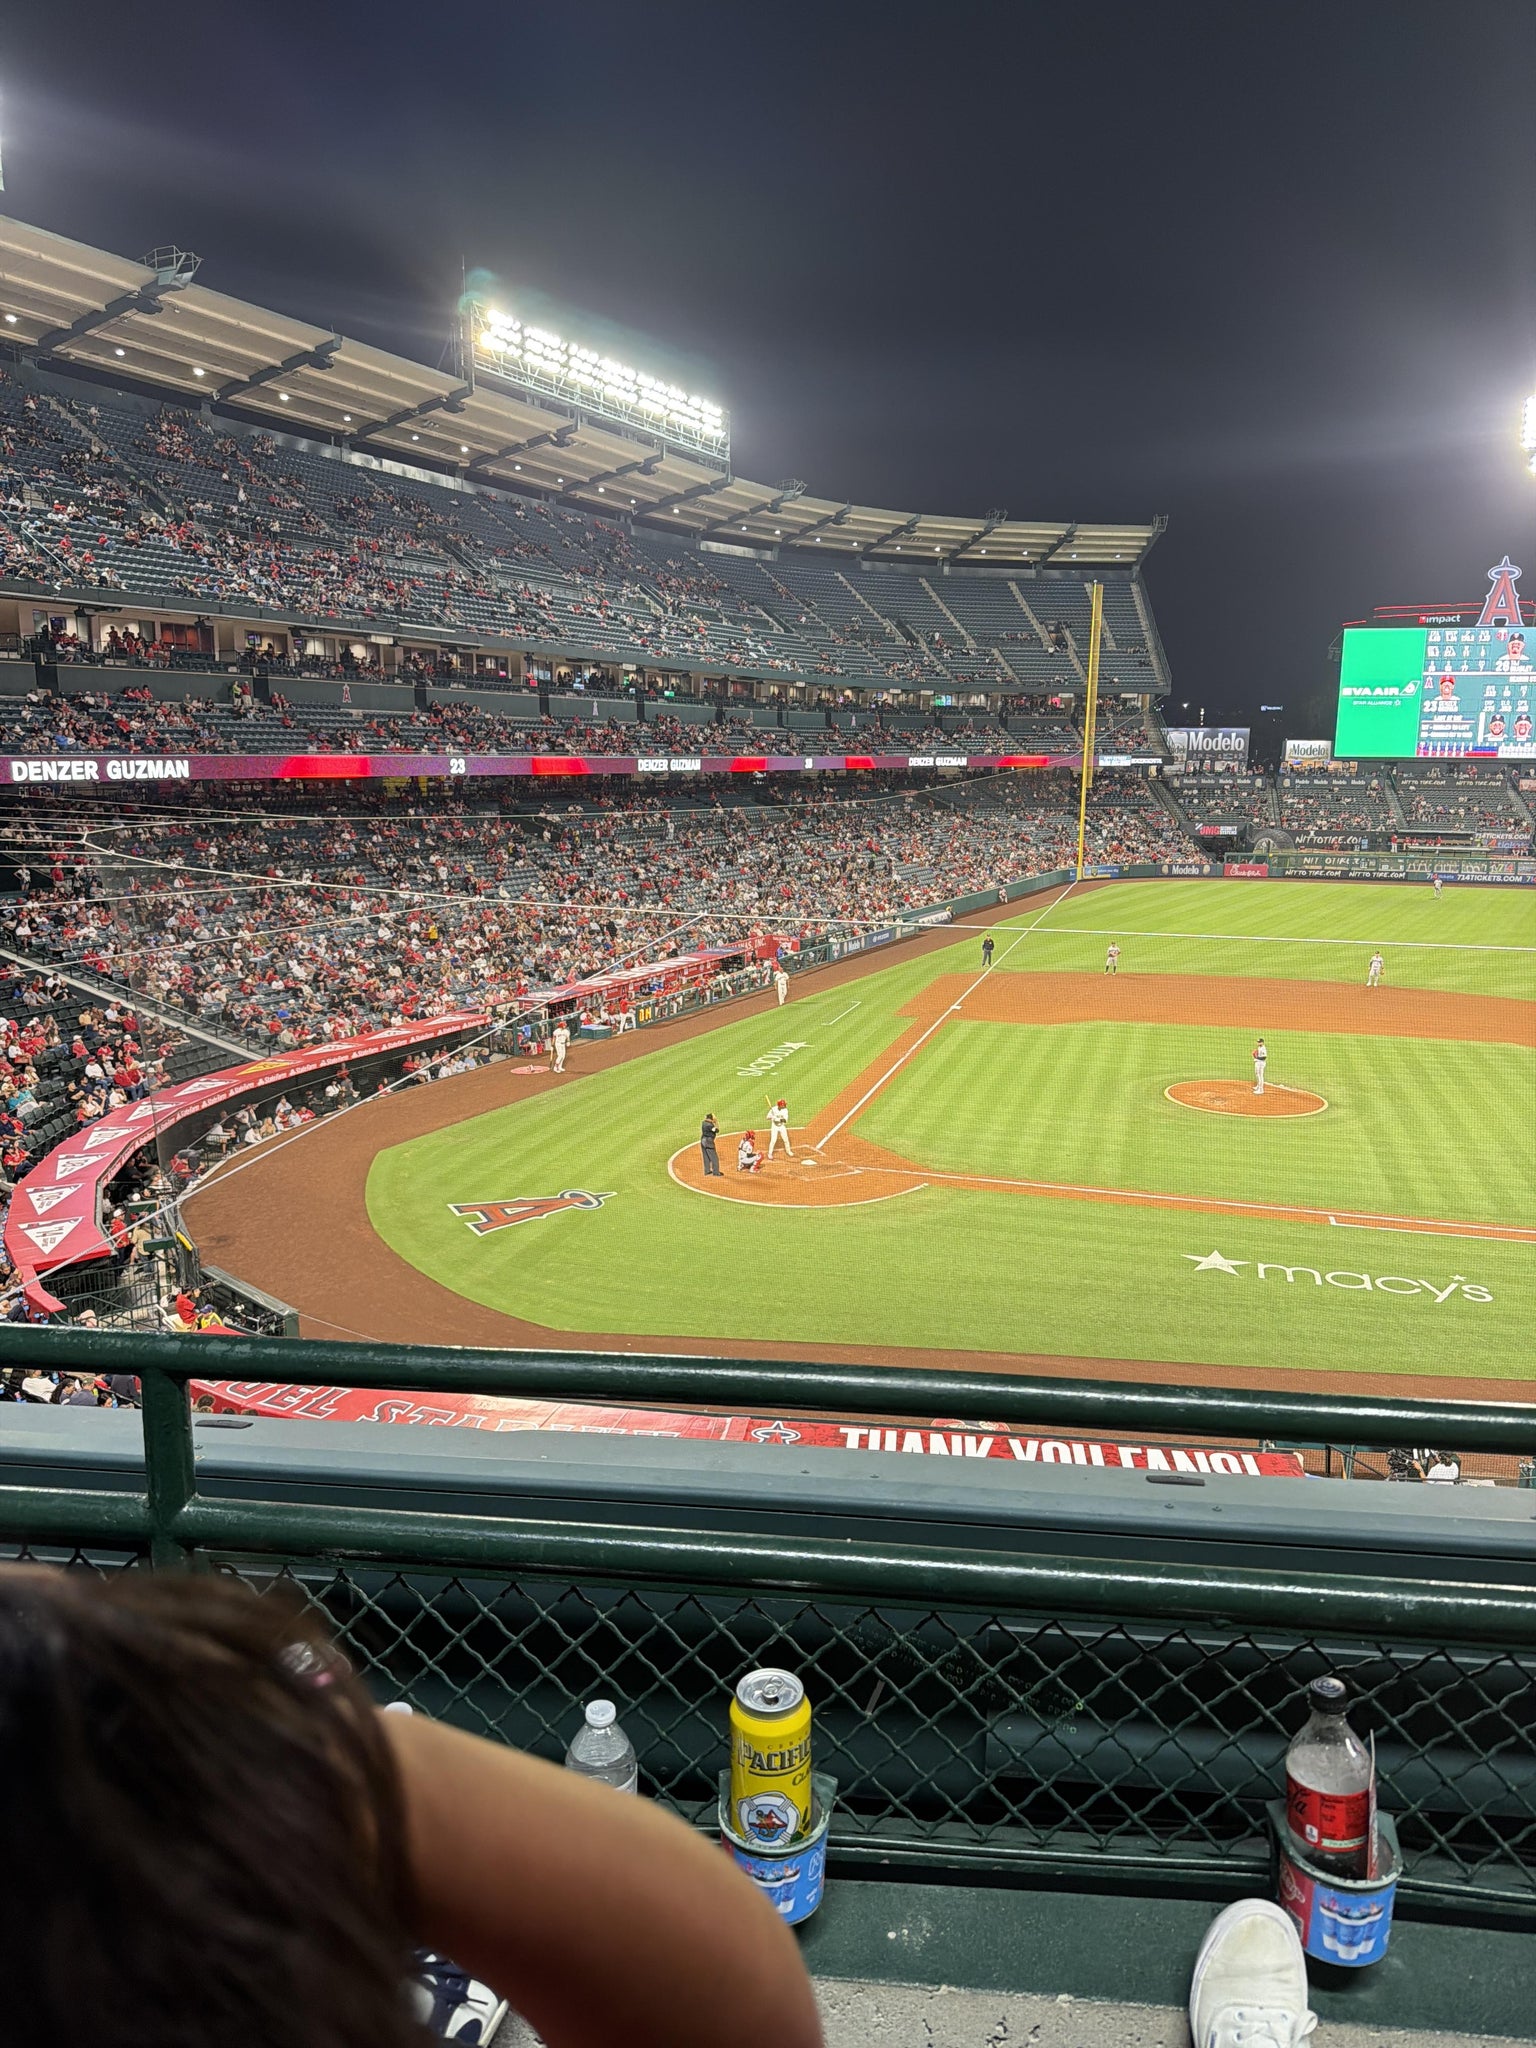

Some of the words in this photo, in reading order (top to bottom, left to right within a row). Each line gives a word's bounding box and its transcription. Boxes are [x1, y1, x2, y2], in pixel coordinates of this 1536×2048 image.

[1188, 731, 1245, 751] Modelo
[1292, 743, 1326, 756] Modelo
[11, 760, 100, 782] DENZER
[105, 759, 190, 780] GUZMAN
[449, 758, 467, 774] 23
[637, 758, 669, 772] DENZER
[669, 758, 701, 771] GUZMAN
[1171, 865, 1199, 875] Modelo
[1285, 869, 1306, 877] NITTO
[1457, 875, 1523, 883] 714TICKETS.COM
